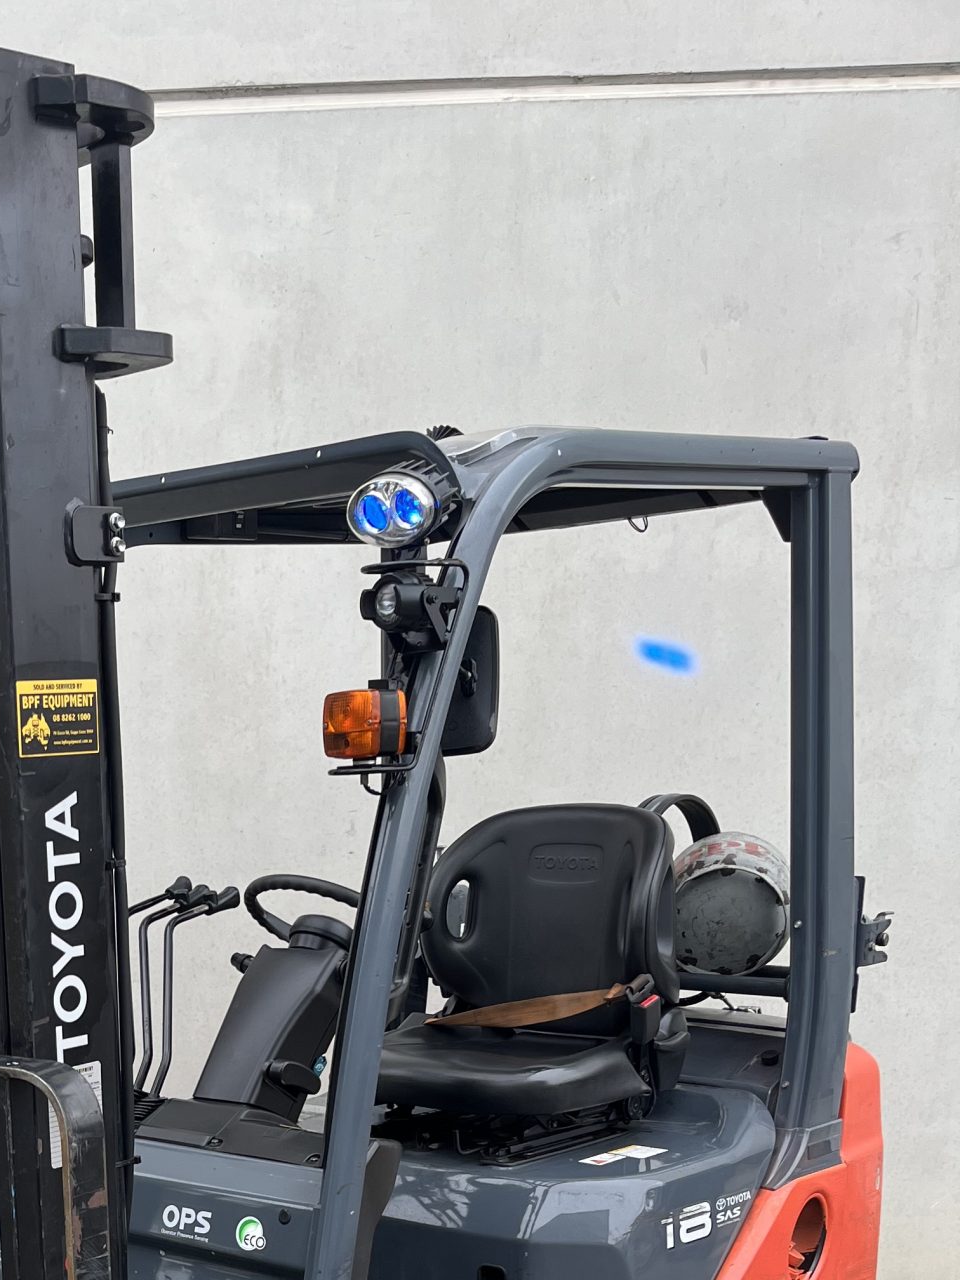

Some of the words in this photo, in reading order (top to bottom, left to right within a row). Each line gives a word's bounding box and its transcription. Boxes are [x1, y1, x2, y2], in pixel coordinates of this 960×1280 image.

[22, 695, 40, 709] BPF
[42, 694, 94, 711] EQUIPMENT
[535, 855, 600, 871] TOYOTA
[44, 791, 89, 1066] TOYOTA
[726, 1191, 751, 1206] TOYOTA
[162, 1204, 212, 1234] OPS
[716, 1206, 741, 1223] SAS
[244, 1234, 265, 1249] ECO
